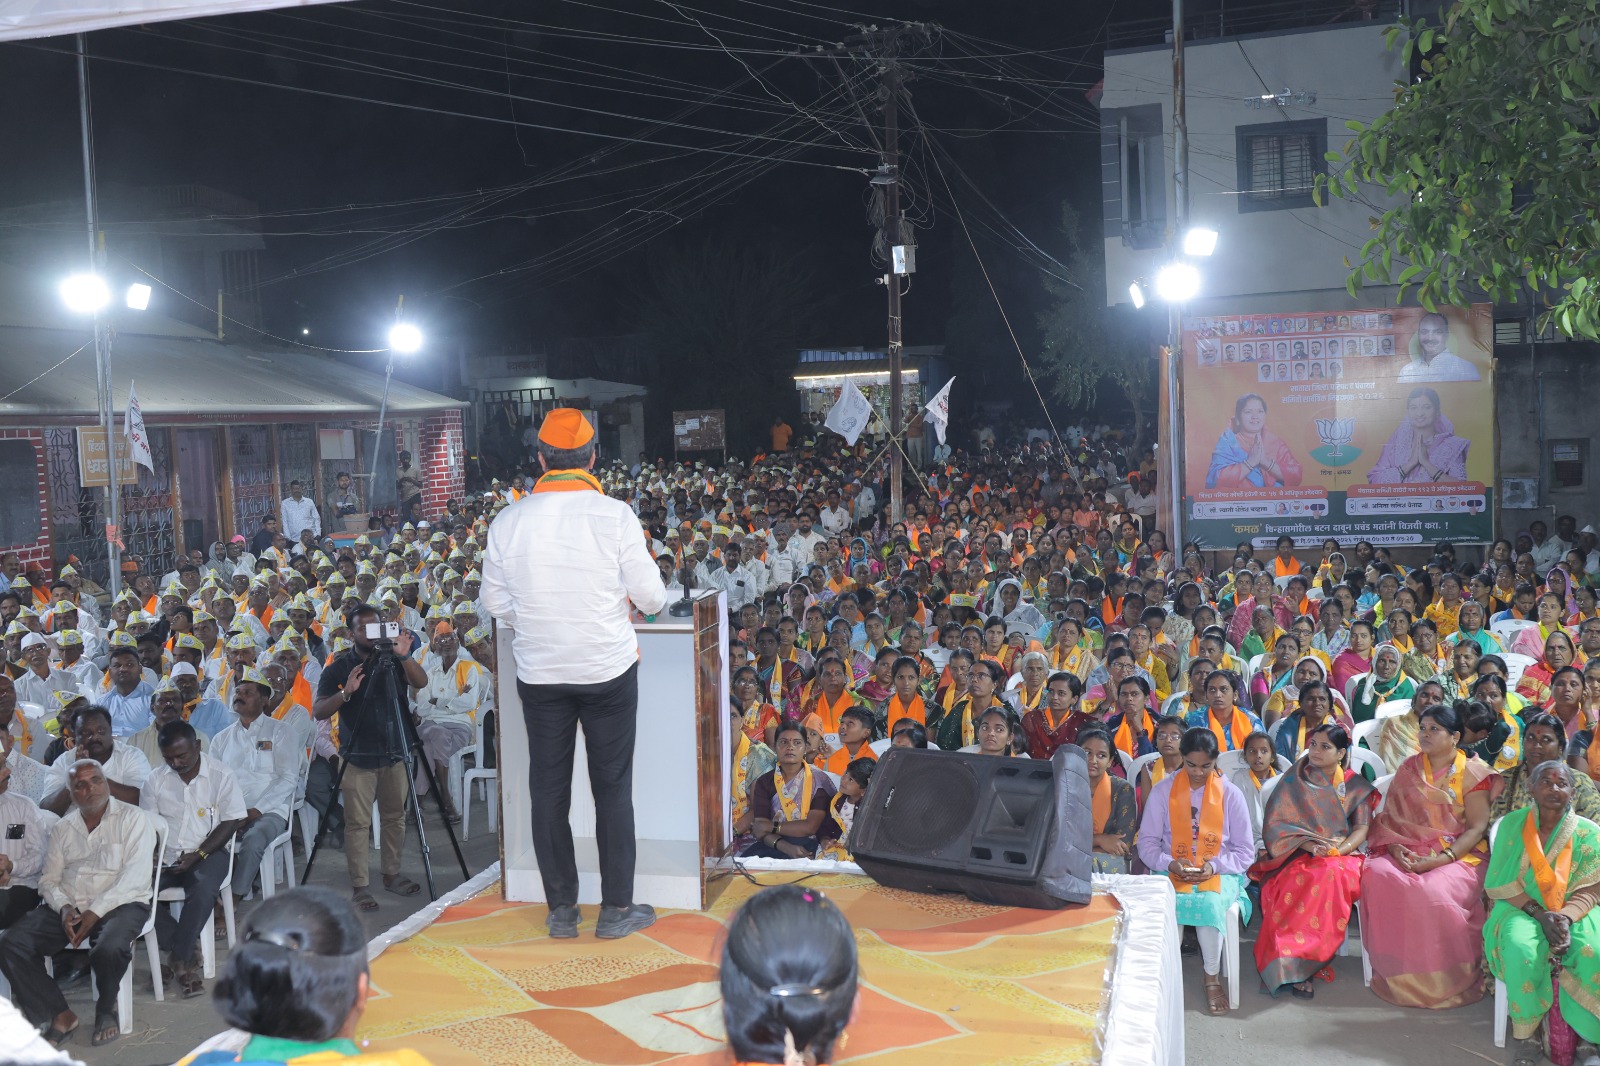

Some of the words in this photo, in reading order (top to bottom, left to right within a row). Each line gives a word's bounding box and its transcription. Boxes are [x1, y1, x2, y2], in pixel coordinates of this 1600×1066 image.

[1355, 381, 1376, 389] पंचायत
[1265, 522, 1312, 534] चिन्हासमोरील
[1314, 524, 1330, 532] बटन
[1332, 523, 1352, 534] दाबून
[1354, 522, 1370, 532] प्रचंड
[1372, 520, 1396, 531] मतांनी
[1398, 520, 1422, 530] विजयी
